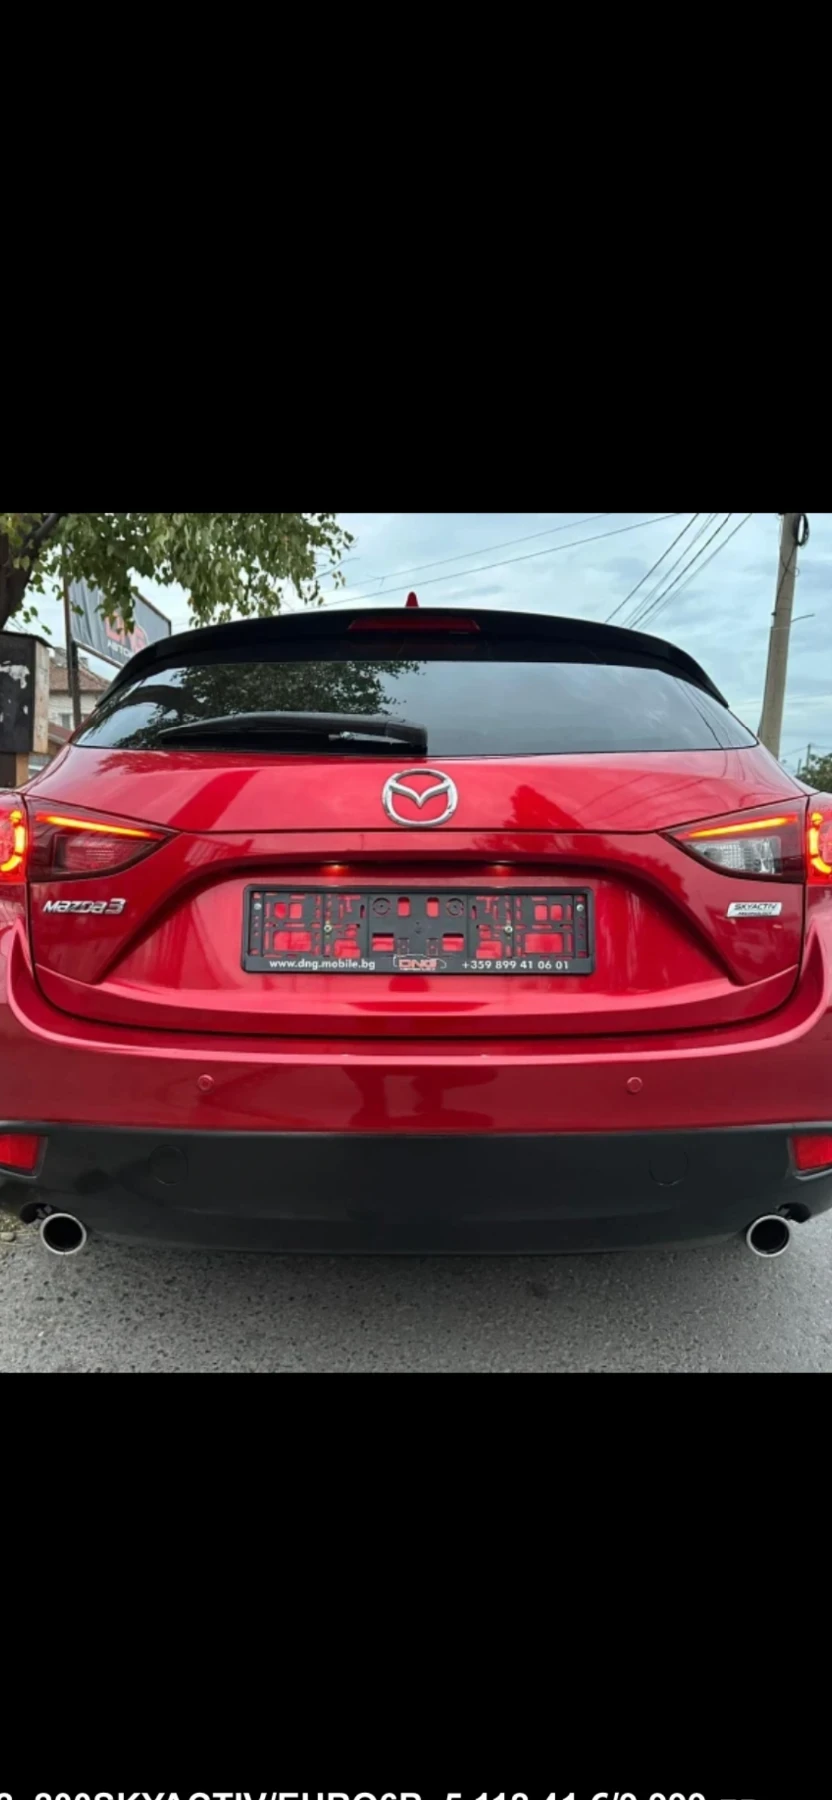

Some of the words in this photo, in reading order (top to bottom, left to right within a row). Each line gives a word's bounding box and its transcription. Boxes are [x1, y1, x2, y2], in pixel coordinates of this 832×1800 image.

[269, 958, 376, 970] www.dng.mobile.bg
[462, 960, 492, 970] +359
[495, 960, 517, 970] 899
[520, 960, 533, 970] 41
[537, 960, 552, 970] 06
[555, 960, 569, 970] 01
